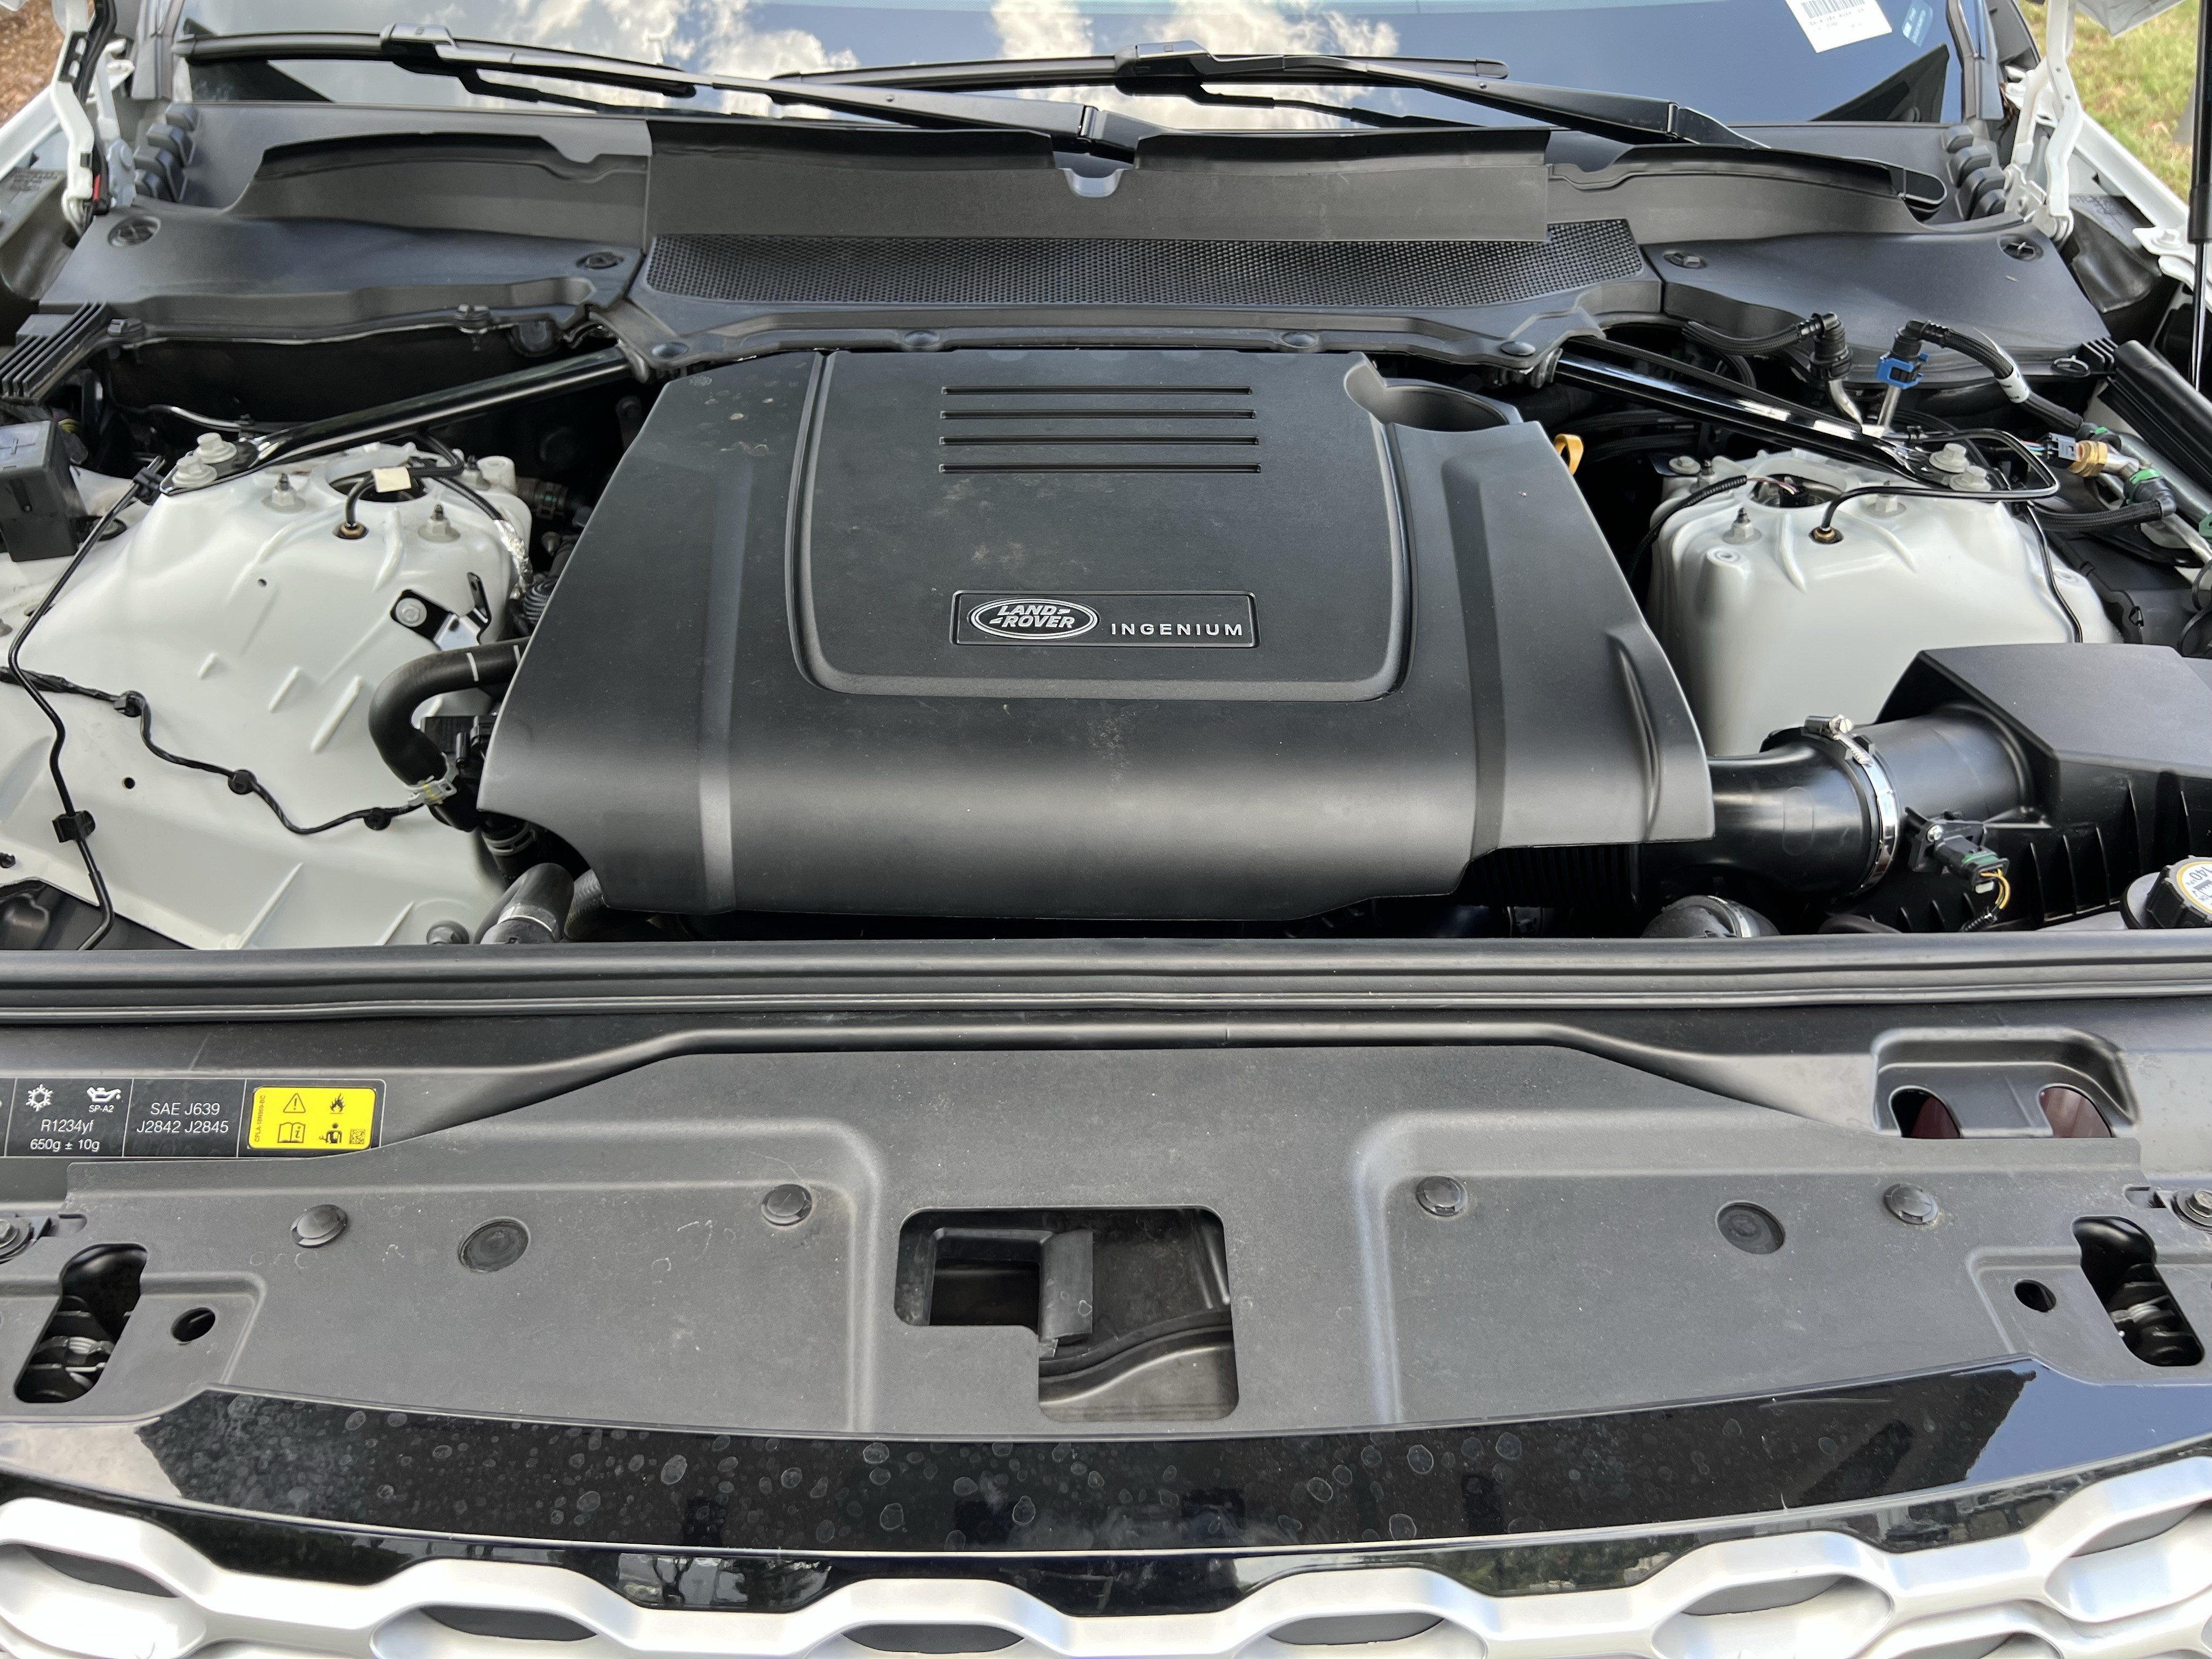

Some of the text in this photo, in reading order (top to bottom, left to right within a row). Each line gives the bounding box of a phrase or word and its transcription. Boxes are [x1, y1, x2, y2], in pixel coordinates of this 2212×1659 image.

[997, 605, 1057, 616] LAND
[1001, 616, 1075, 628] ROVER
[1111, 623, 1243, 636] INGENIUM
[150, 1102, 220, 1115] SAE J639
[40, 1119, 94, 1135] R1234yf
[137, 1120, 229, 1133] J2842 J2845
[30, 1138, 61, 1152] 650g
[78, 1138, 100, 1152] 10g
